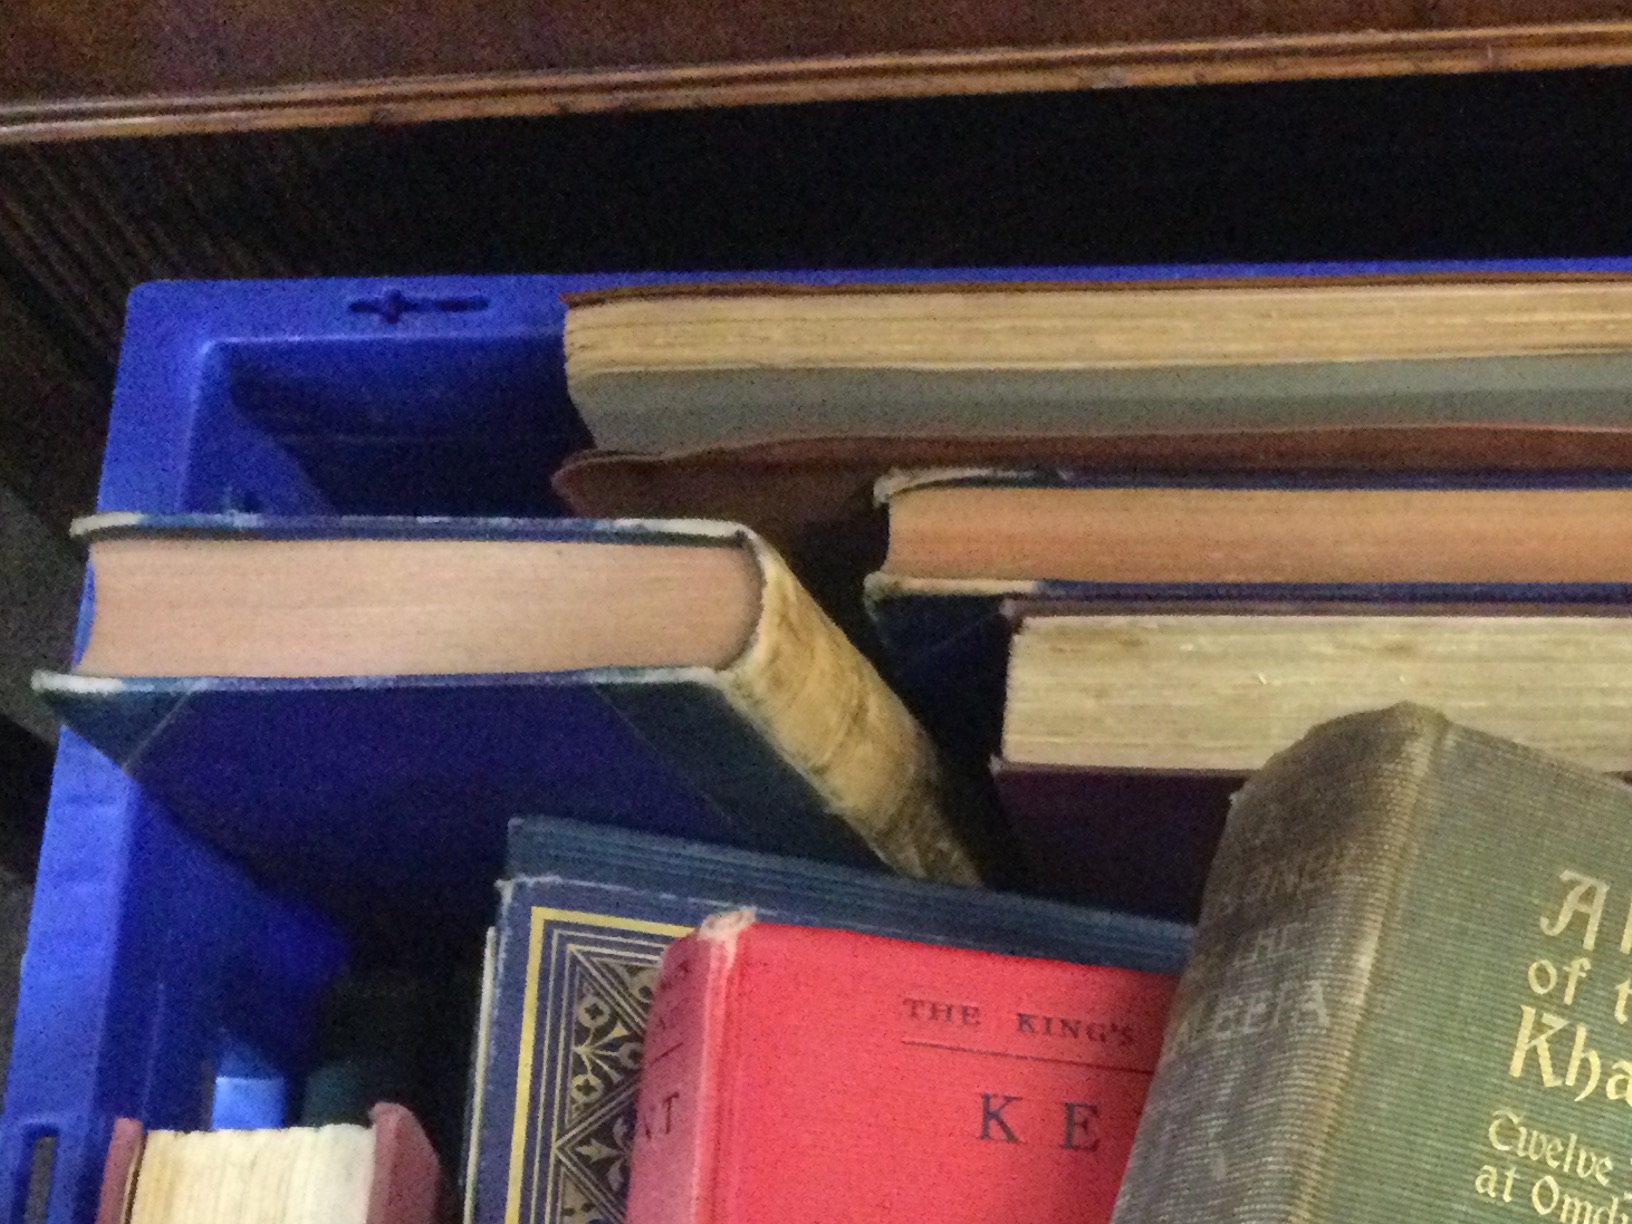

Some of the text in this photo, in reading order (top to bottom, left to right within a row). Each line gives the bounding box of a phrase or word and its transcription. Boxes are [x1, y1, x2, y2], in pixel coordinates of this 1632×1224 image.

[1540, 869, 1610, 952] A
[1527, 957, 1592, 1006] of
[902, 998, 1135, 1048] THE KING'S
[1487, 1108, 1614, 1187] Twelve
[1474, 1163, 1521, 1203] at
